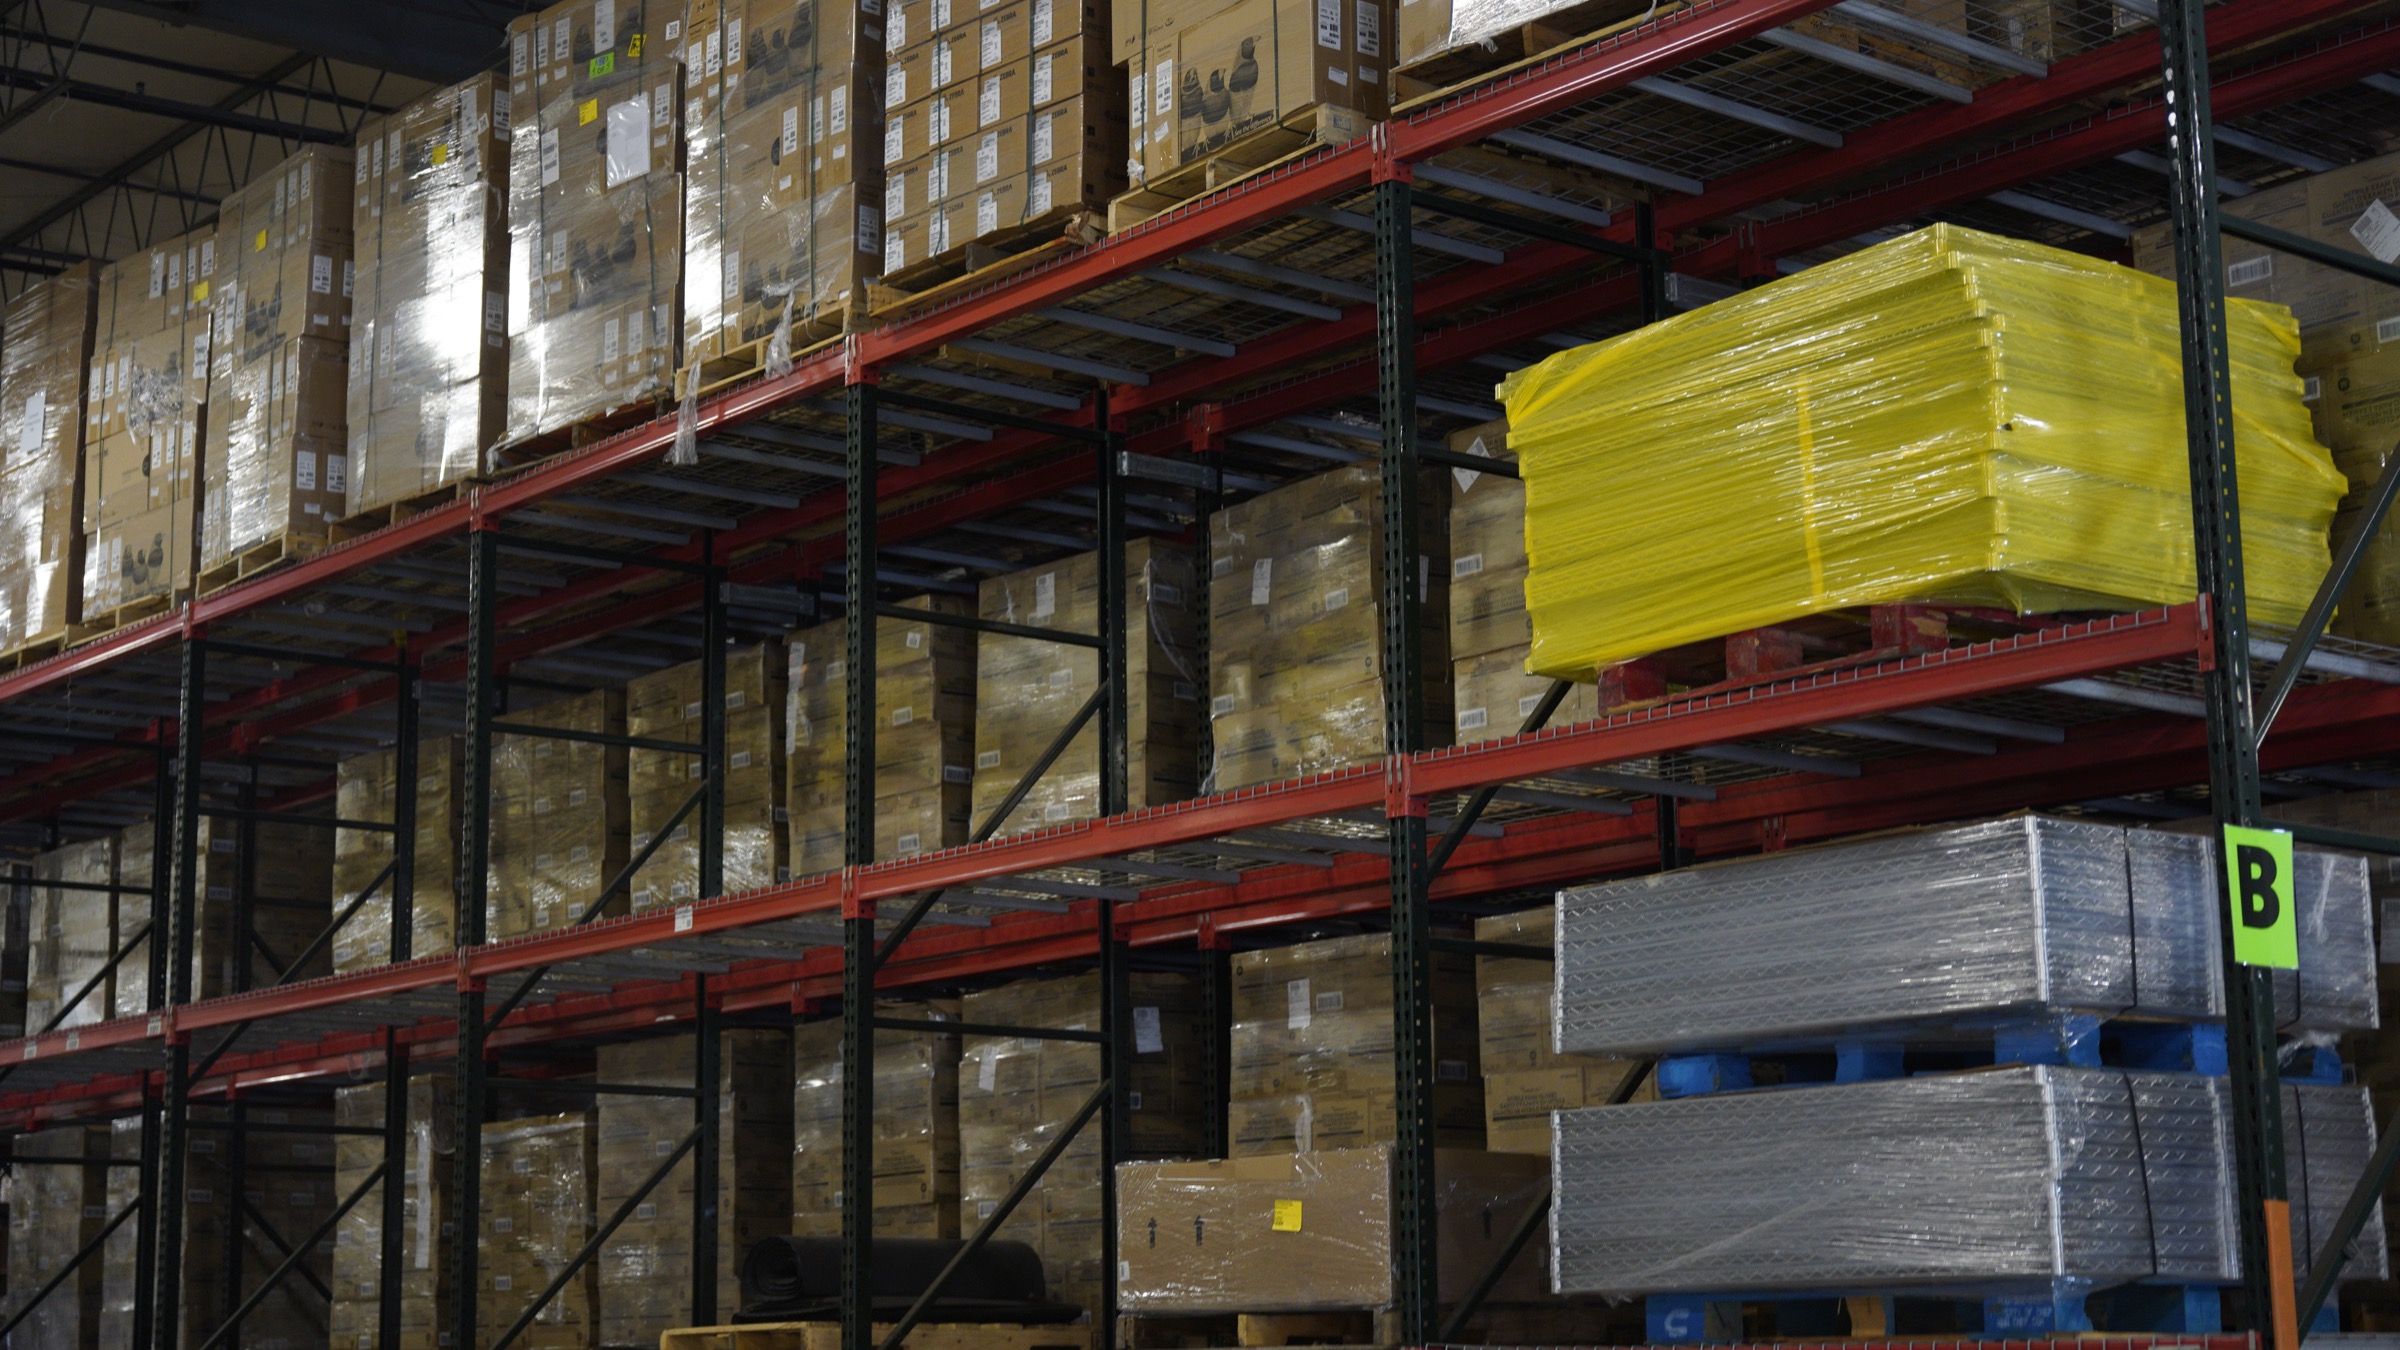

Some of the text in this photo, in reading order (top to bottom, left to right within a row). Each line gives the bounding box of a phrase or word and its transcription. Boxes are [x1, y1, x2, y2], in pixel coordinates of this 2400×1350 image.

[1001, 11, 1017, 23] ZEBRA
[951, 32, 967, 44] ZEBRA
[1052, 48, 1068, 60] ZEBRA
[1000, 69, 1015, 81] ZEBRA
[1052, 108, 1068, 119] ZEBRA
[1051, 165, 1068, 176] ZEBRA
[2236, 844, 2280, 930] B
